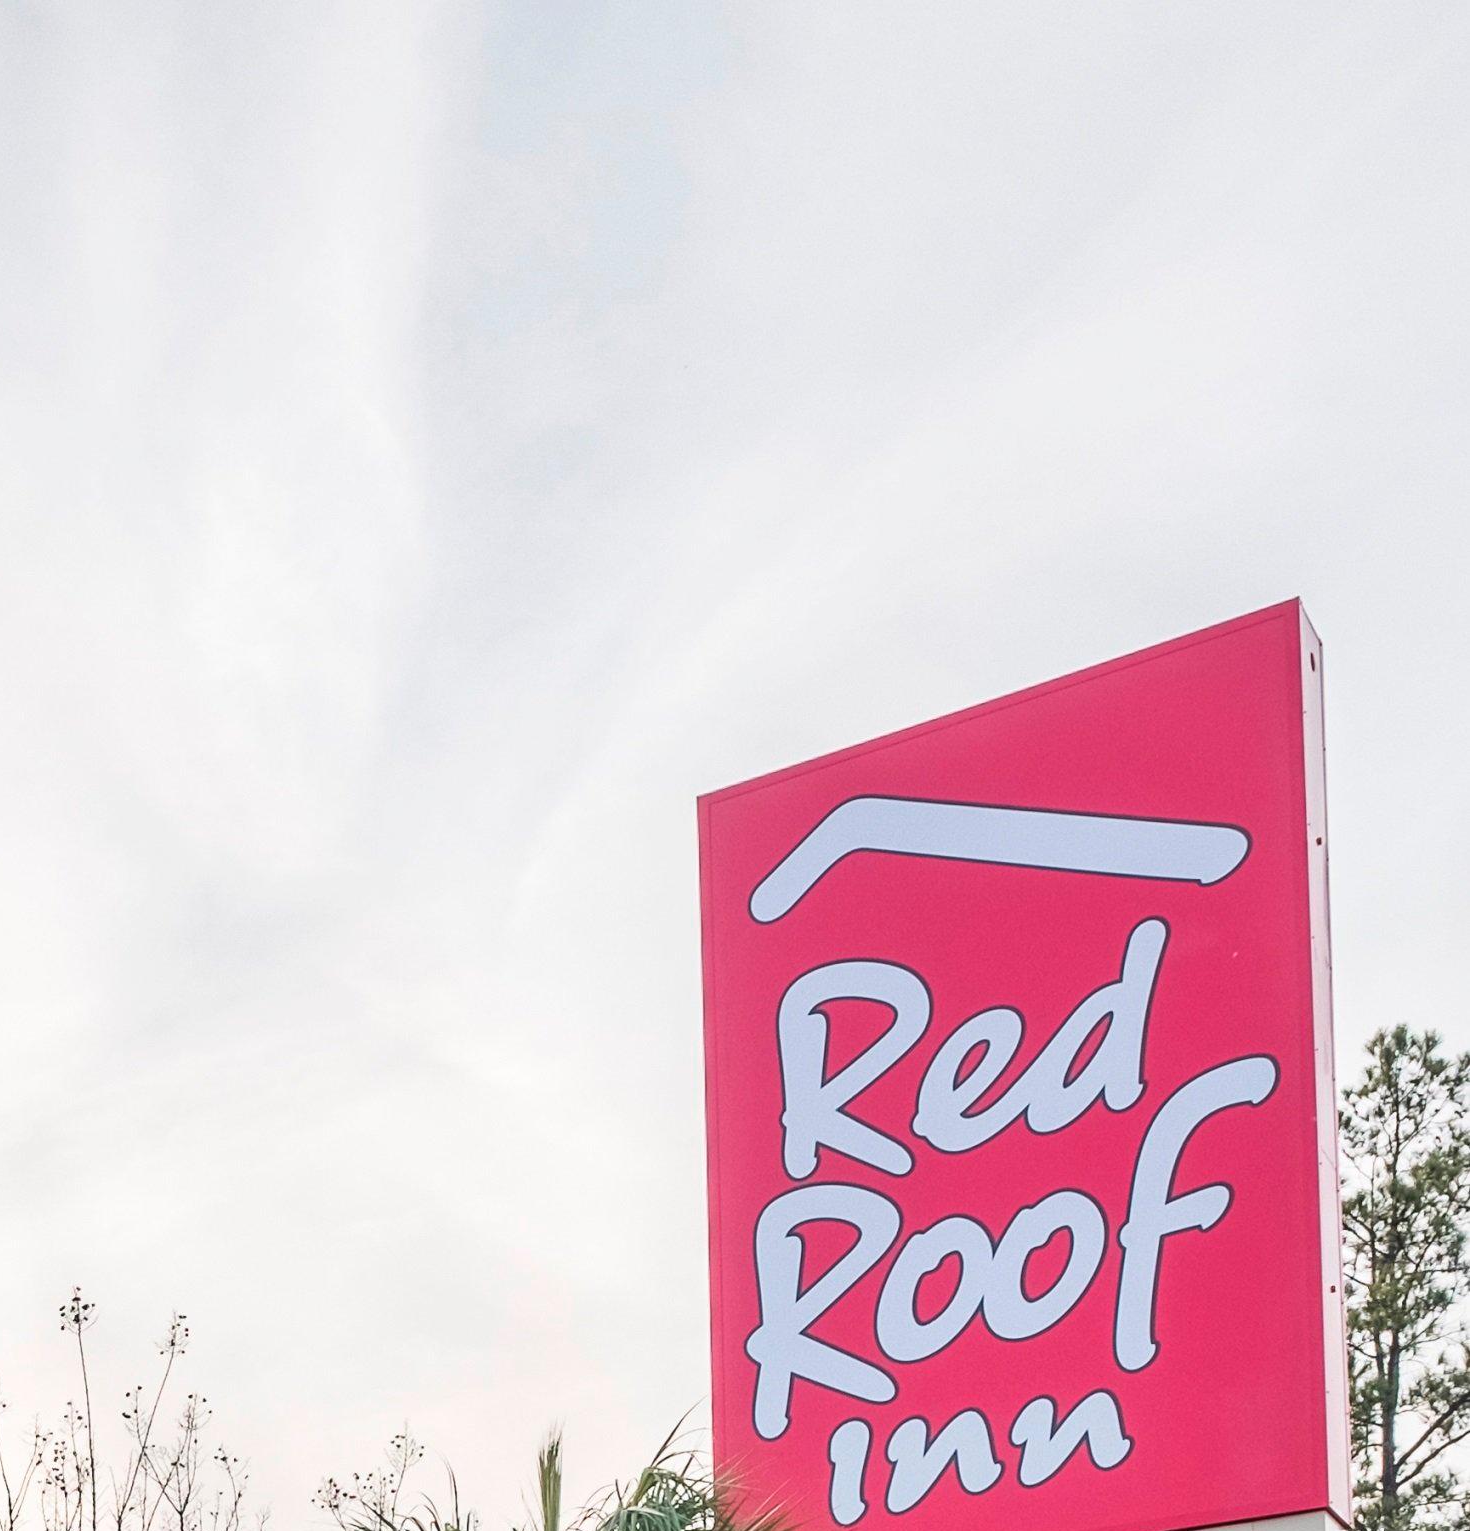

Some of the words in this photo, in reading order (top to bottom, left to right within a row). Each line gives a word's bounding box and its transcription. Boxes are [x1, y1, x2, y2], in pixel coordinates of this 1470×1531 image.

[776, 916, 1169, 1180] Red
[744, 1055, 1279, 1441] Roof
[827, 1390, 1133, 1526] inn
